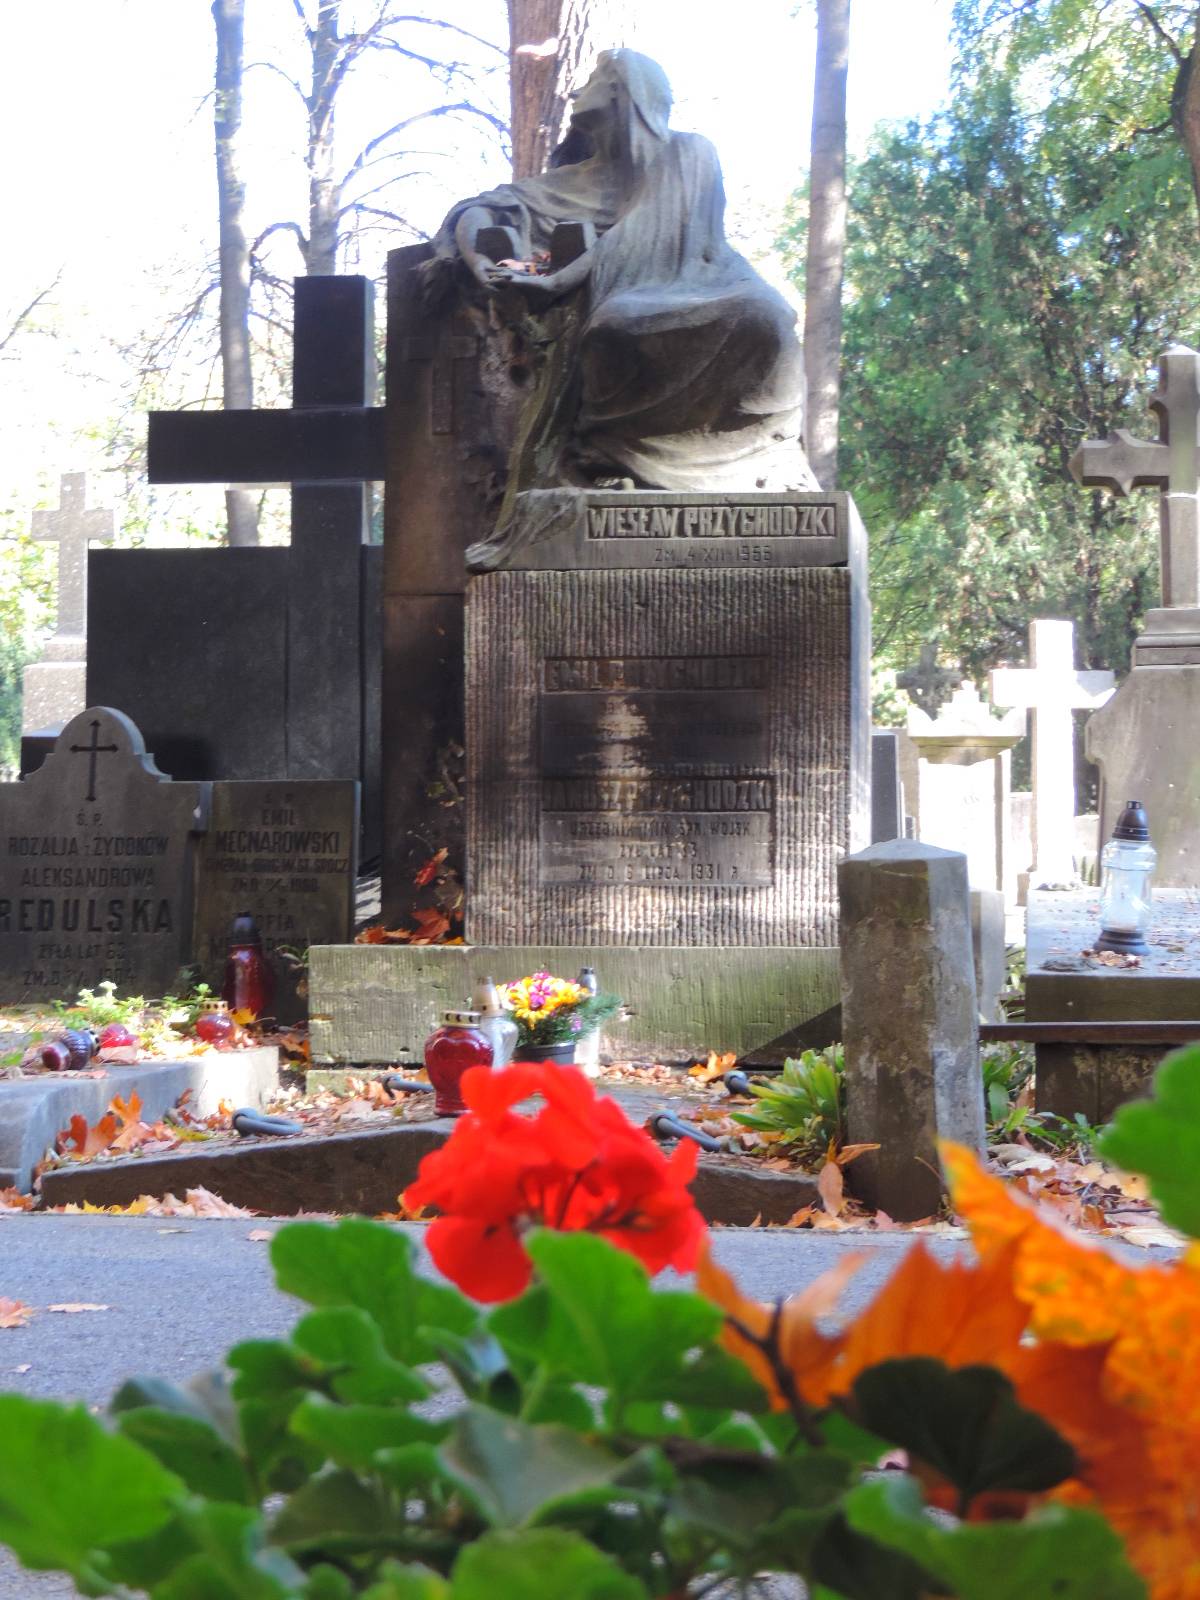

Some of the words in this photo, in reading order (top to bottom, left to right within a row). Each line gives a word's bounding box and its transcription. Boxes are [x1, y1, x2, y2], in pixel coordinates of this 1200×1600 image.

[684, 506, 836, 537] PRZYCHODZKI
[261, 808, 297, 826] EMIL
[21, 867, 155, 888] ALEKSANDROWA
[690, 863, 720, 880] 1931
